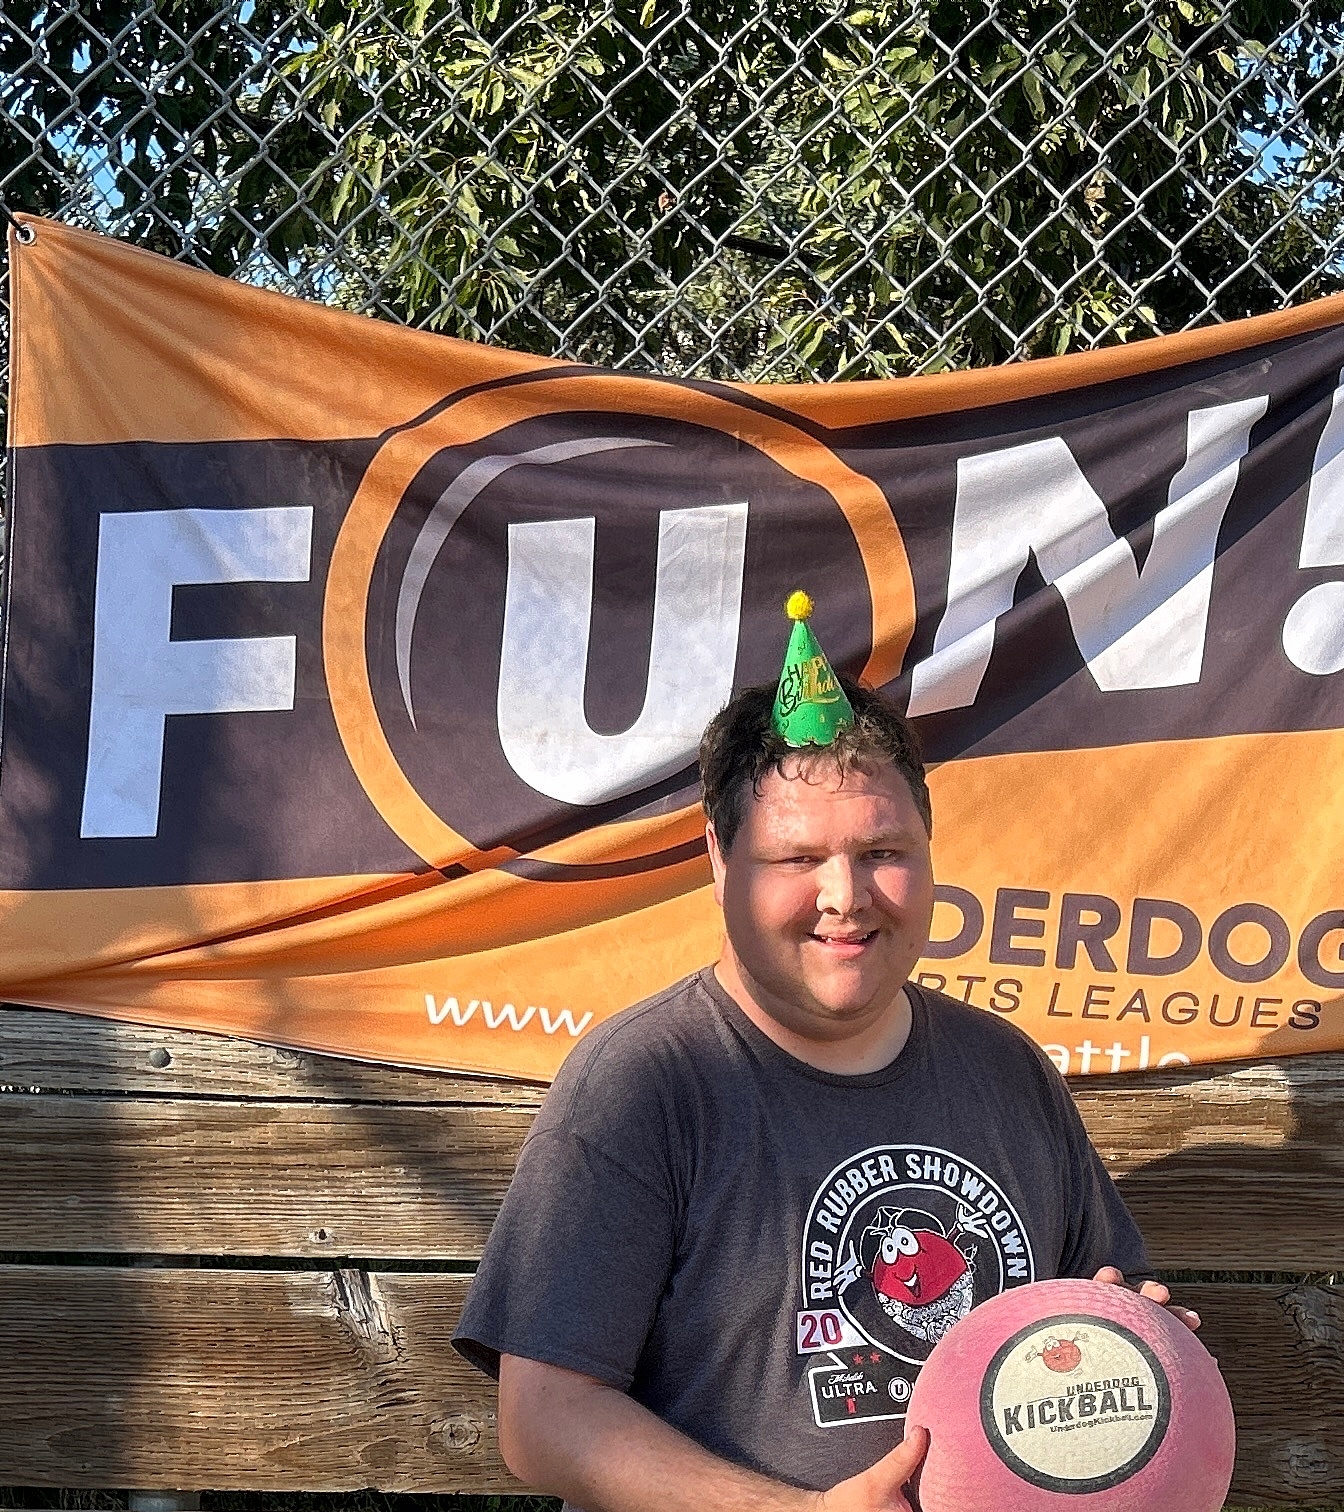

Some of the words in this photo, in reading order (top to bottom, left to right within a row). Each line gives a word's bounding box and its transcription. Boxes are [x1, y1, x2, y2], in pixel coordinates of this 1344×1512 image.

[1046, 981, 1323, 1031] LEAGUES
[815, 1154, 899, 1234] RUBBER
[905, 1152, 1029, 1279] SHOWDOWN
[809, 1240, 834, 1300] RED
[821, 1380, 876, 1399] ULTRA
[1003, 1386, 1153, 1436] KICKBALL
[1066, 1376, 1140, 1396] UNDERDOG
